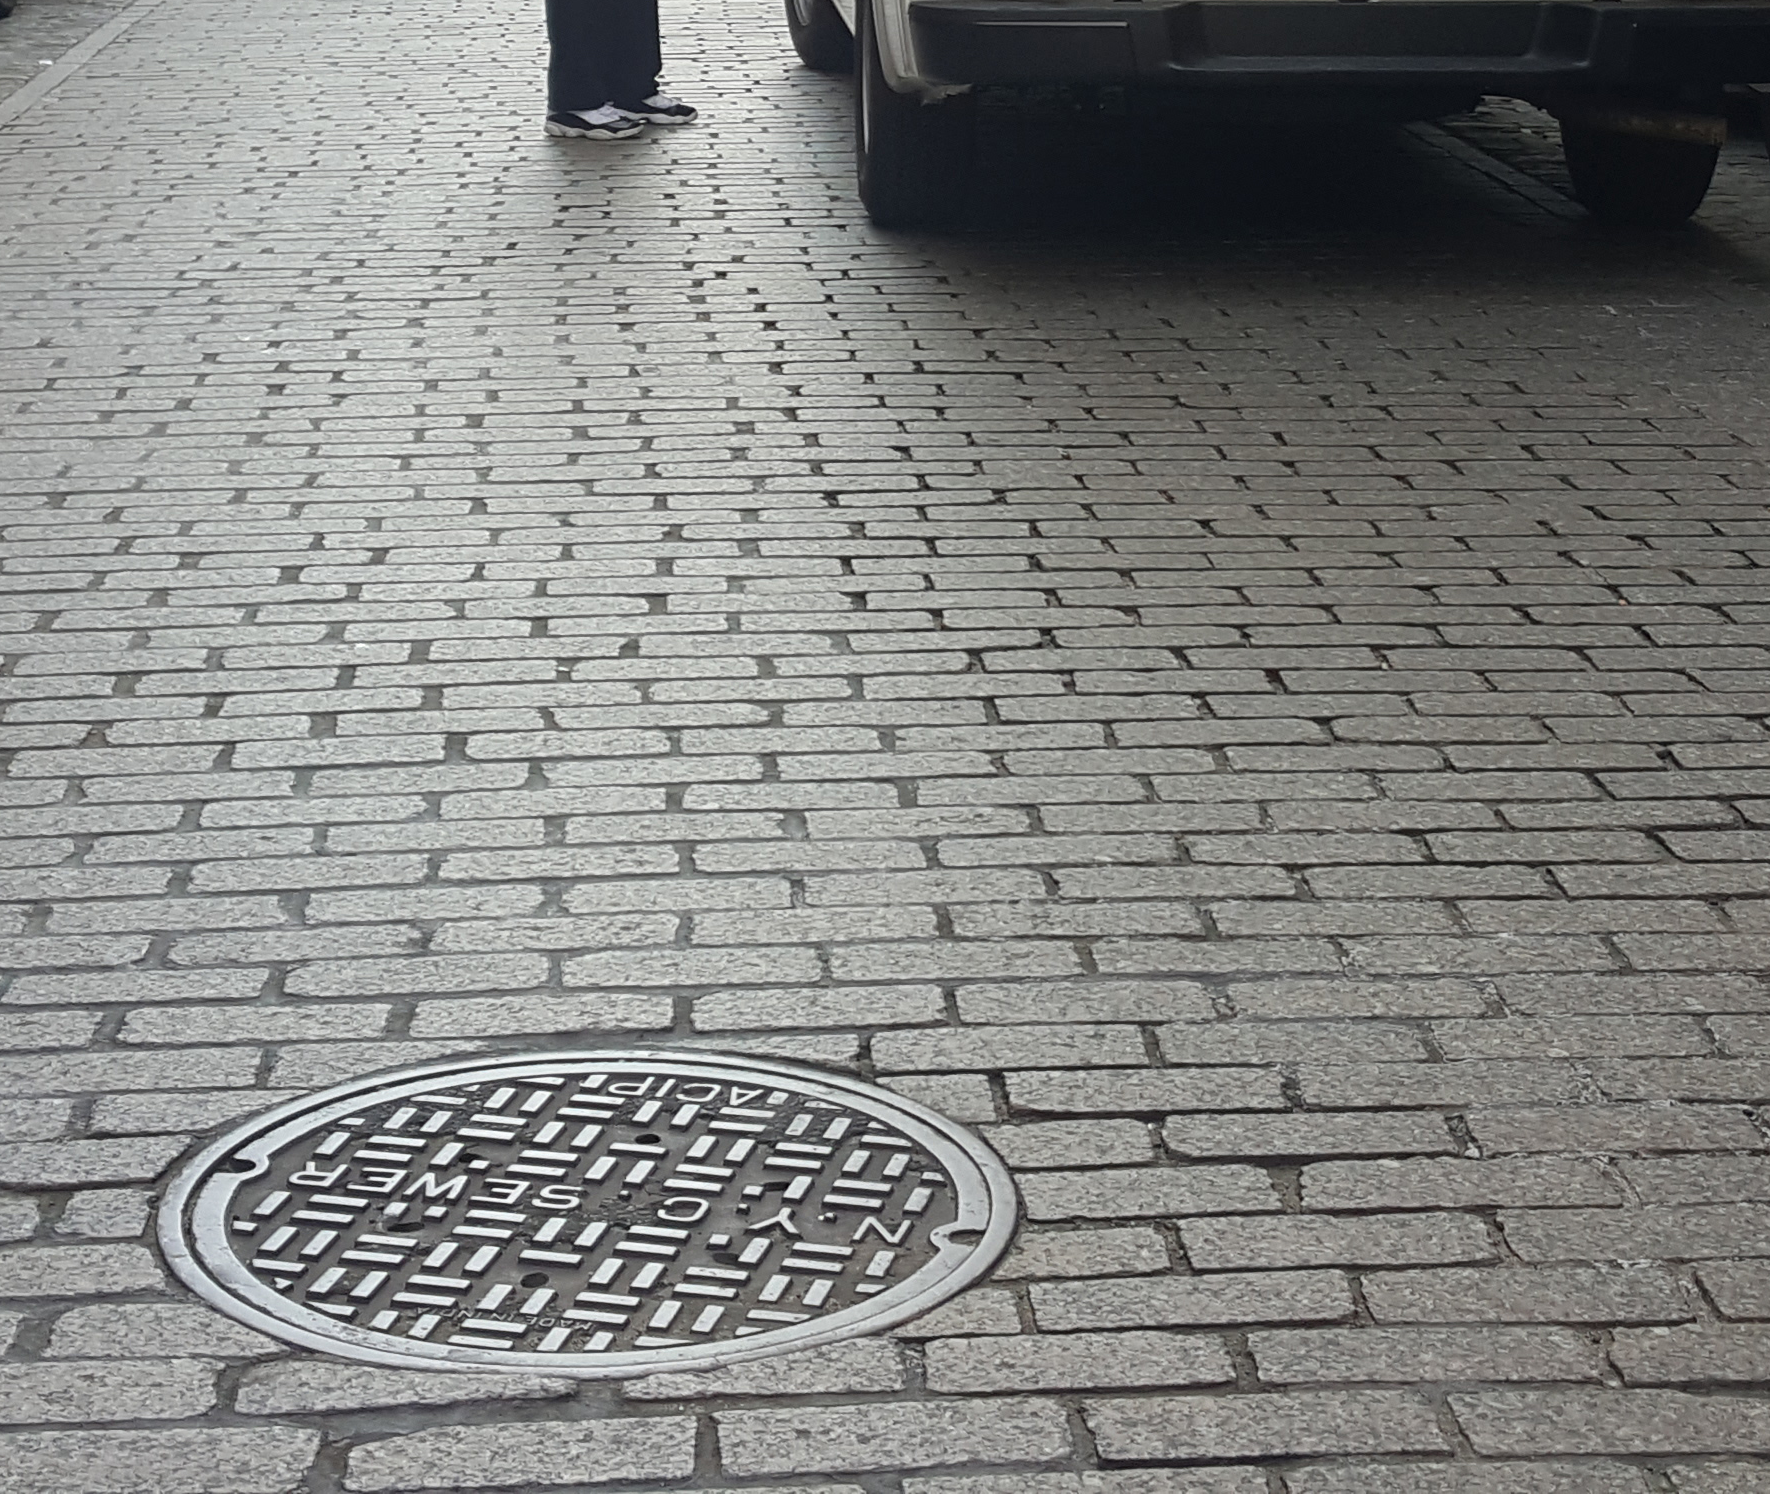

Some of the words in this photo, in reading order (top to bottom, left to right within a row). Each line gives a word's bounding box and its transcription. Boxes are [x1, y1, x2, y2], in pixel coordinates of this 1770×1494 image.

[287, 1161, 586, 1210] SEWER
[492, 1311, 516, 1322] IN
[526, 1314, 597, 1331] MADE
